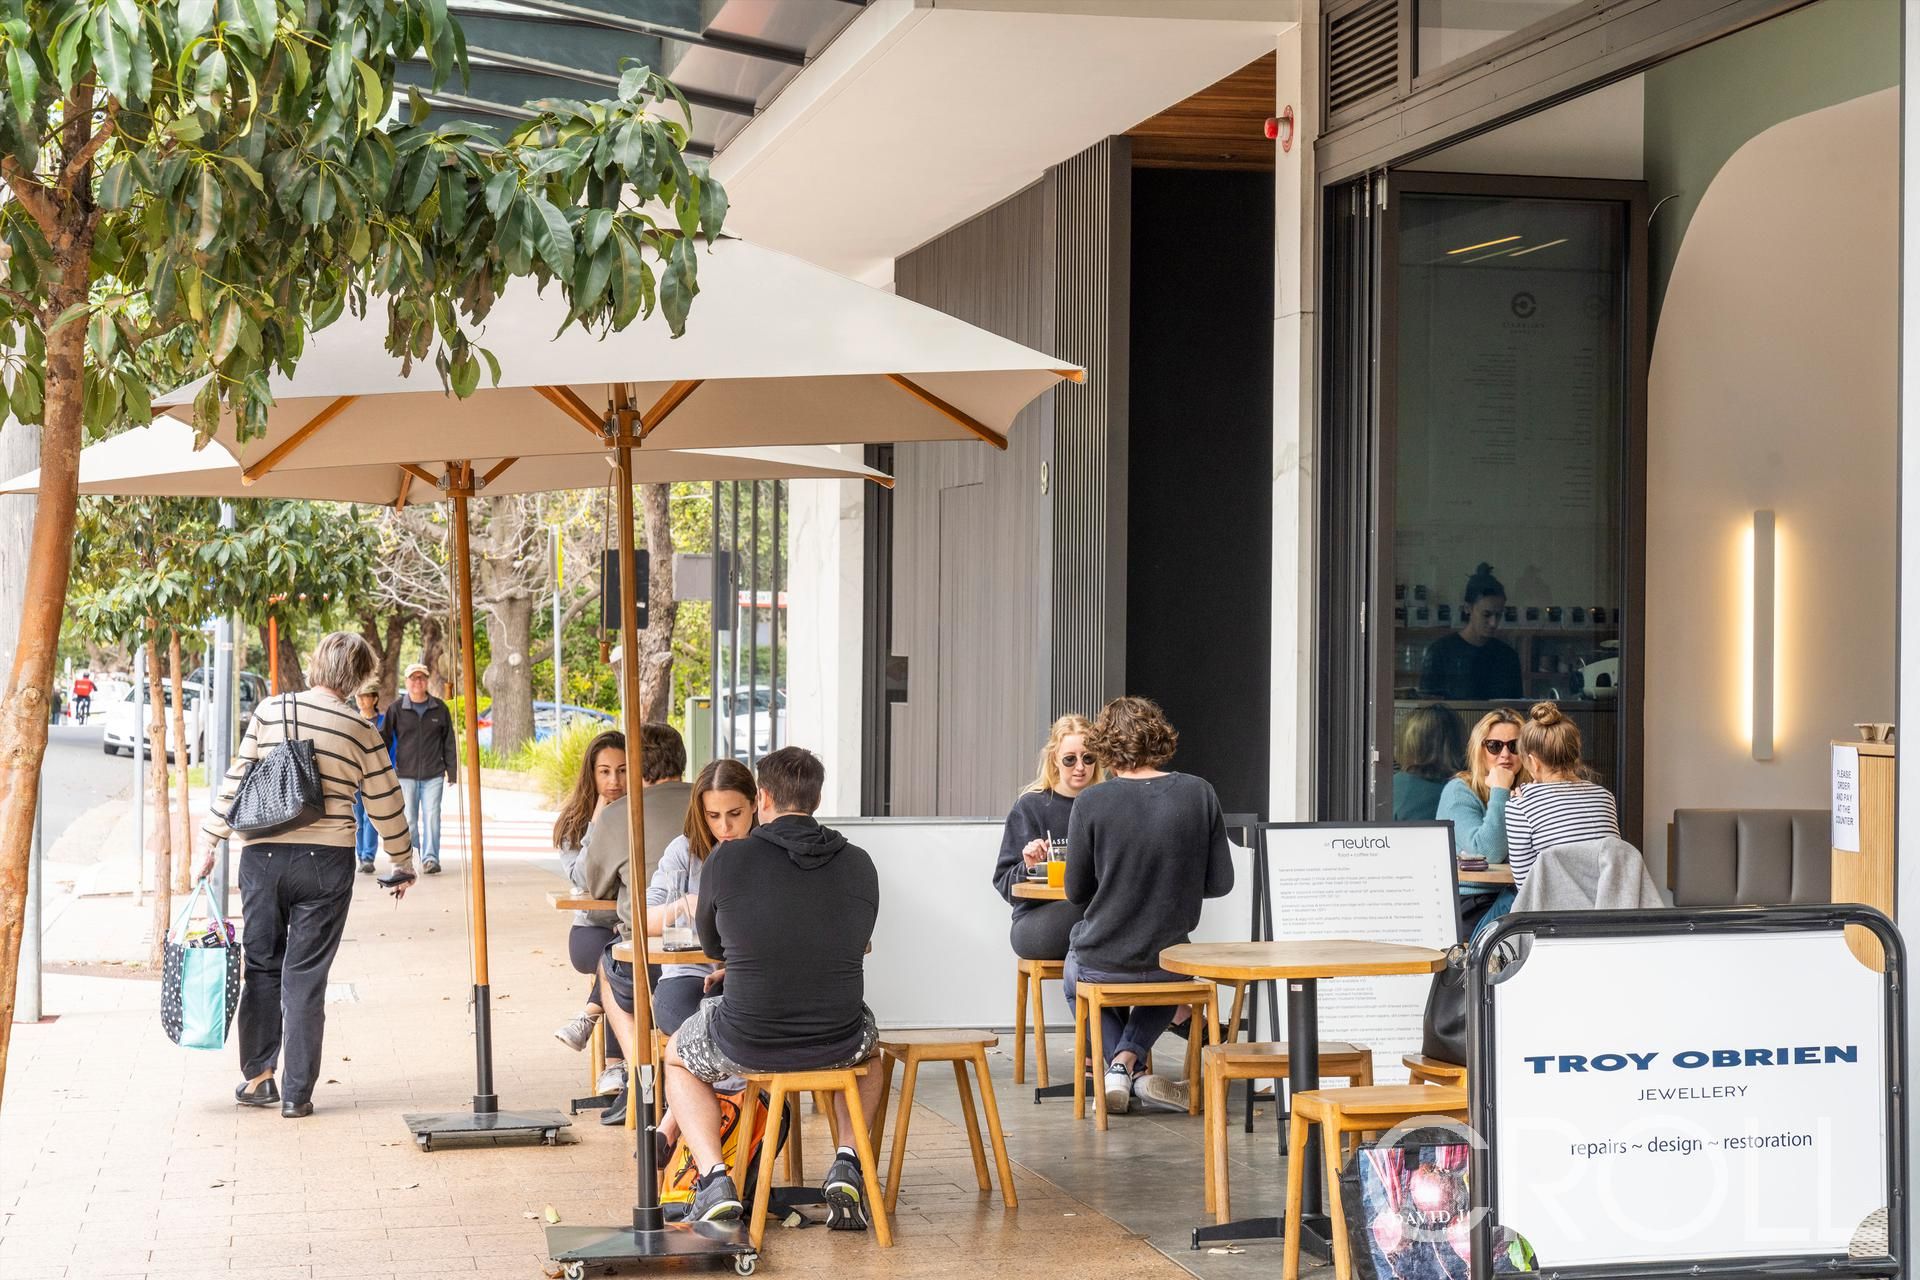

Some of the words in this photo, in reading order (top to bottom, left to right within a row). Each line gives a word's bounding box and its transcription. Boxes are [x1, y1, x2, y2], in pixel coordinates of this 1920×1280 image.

[1836, 769, 1852, 779] PLEASE
[1837, 781, 1851, 790] ORDER
[1836, 792, 1844, 801] AND
[1844, 793, 1853, 802] PAY
[1842, 804, 1851, 814] THE
[1835, 815, 1854, 826] COUNTER
[1331, 835, 1391, 850] neutral
[1523, 1052, 1660, 1075] TROY
[1672, 1045, 1858, 1070] OBRIEN
[1637, 1085, 1749, 1101] JEWELLERY
[1570, 1138, 1627, 1159] repairs
[1647, 1135, 1703, 1156] design
[1723, 1131, 1813, 1150] restoration
